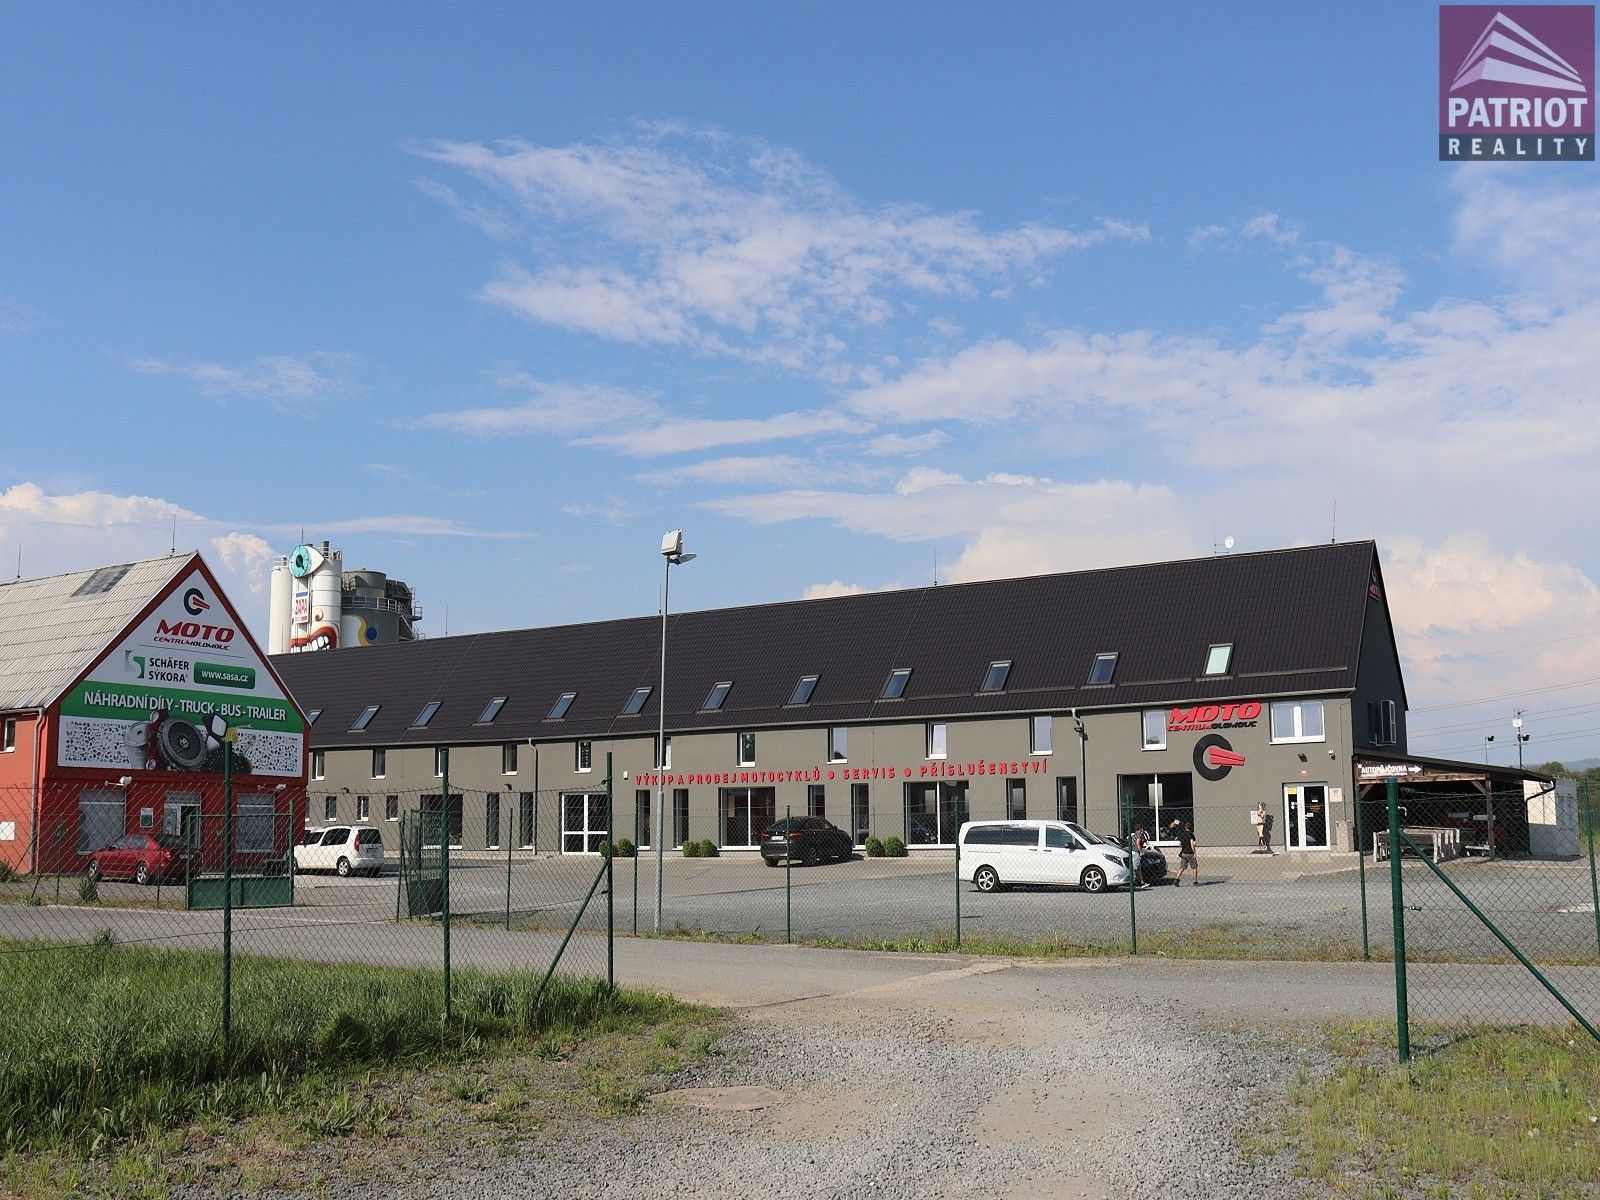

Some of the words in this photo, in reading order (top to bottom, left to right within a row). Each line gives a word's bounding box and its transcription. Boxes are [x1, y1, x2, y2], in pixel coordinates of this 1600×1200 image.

[156, 619, 234, 643] MOTO
[149, 656, 190, 671] SCHÄFER
[201, 669, 249, 683] www.sasa.cz
[84, 690, 149, 710] NÁHRADNÍ
[149, 695, 174, 711] DÍLY
[179, 699, 215, 715] TRUCK
[220, 703, 242, 717] BUS
[247, 705, 286, 721] TRAILER
[1169, 702, 1262, 724] MOTO
[677, 774, 685, 785] A
[688, 772, 737, 784] PRODEJ
[740, 766, 820, 783] MOTOCYKLŮ
[843, 767, 896, 779] SERVIS
[919, 758, 1048, 777] PŘÍSLUŠENSTVÍ
